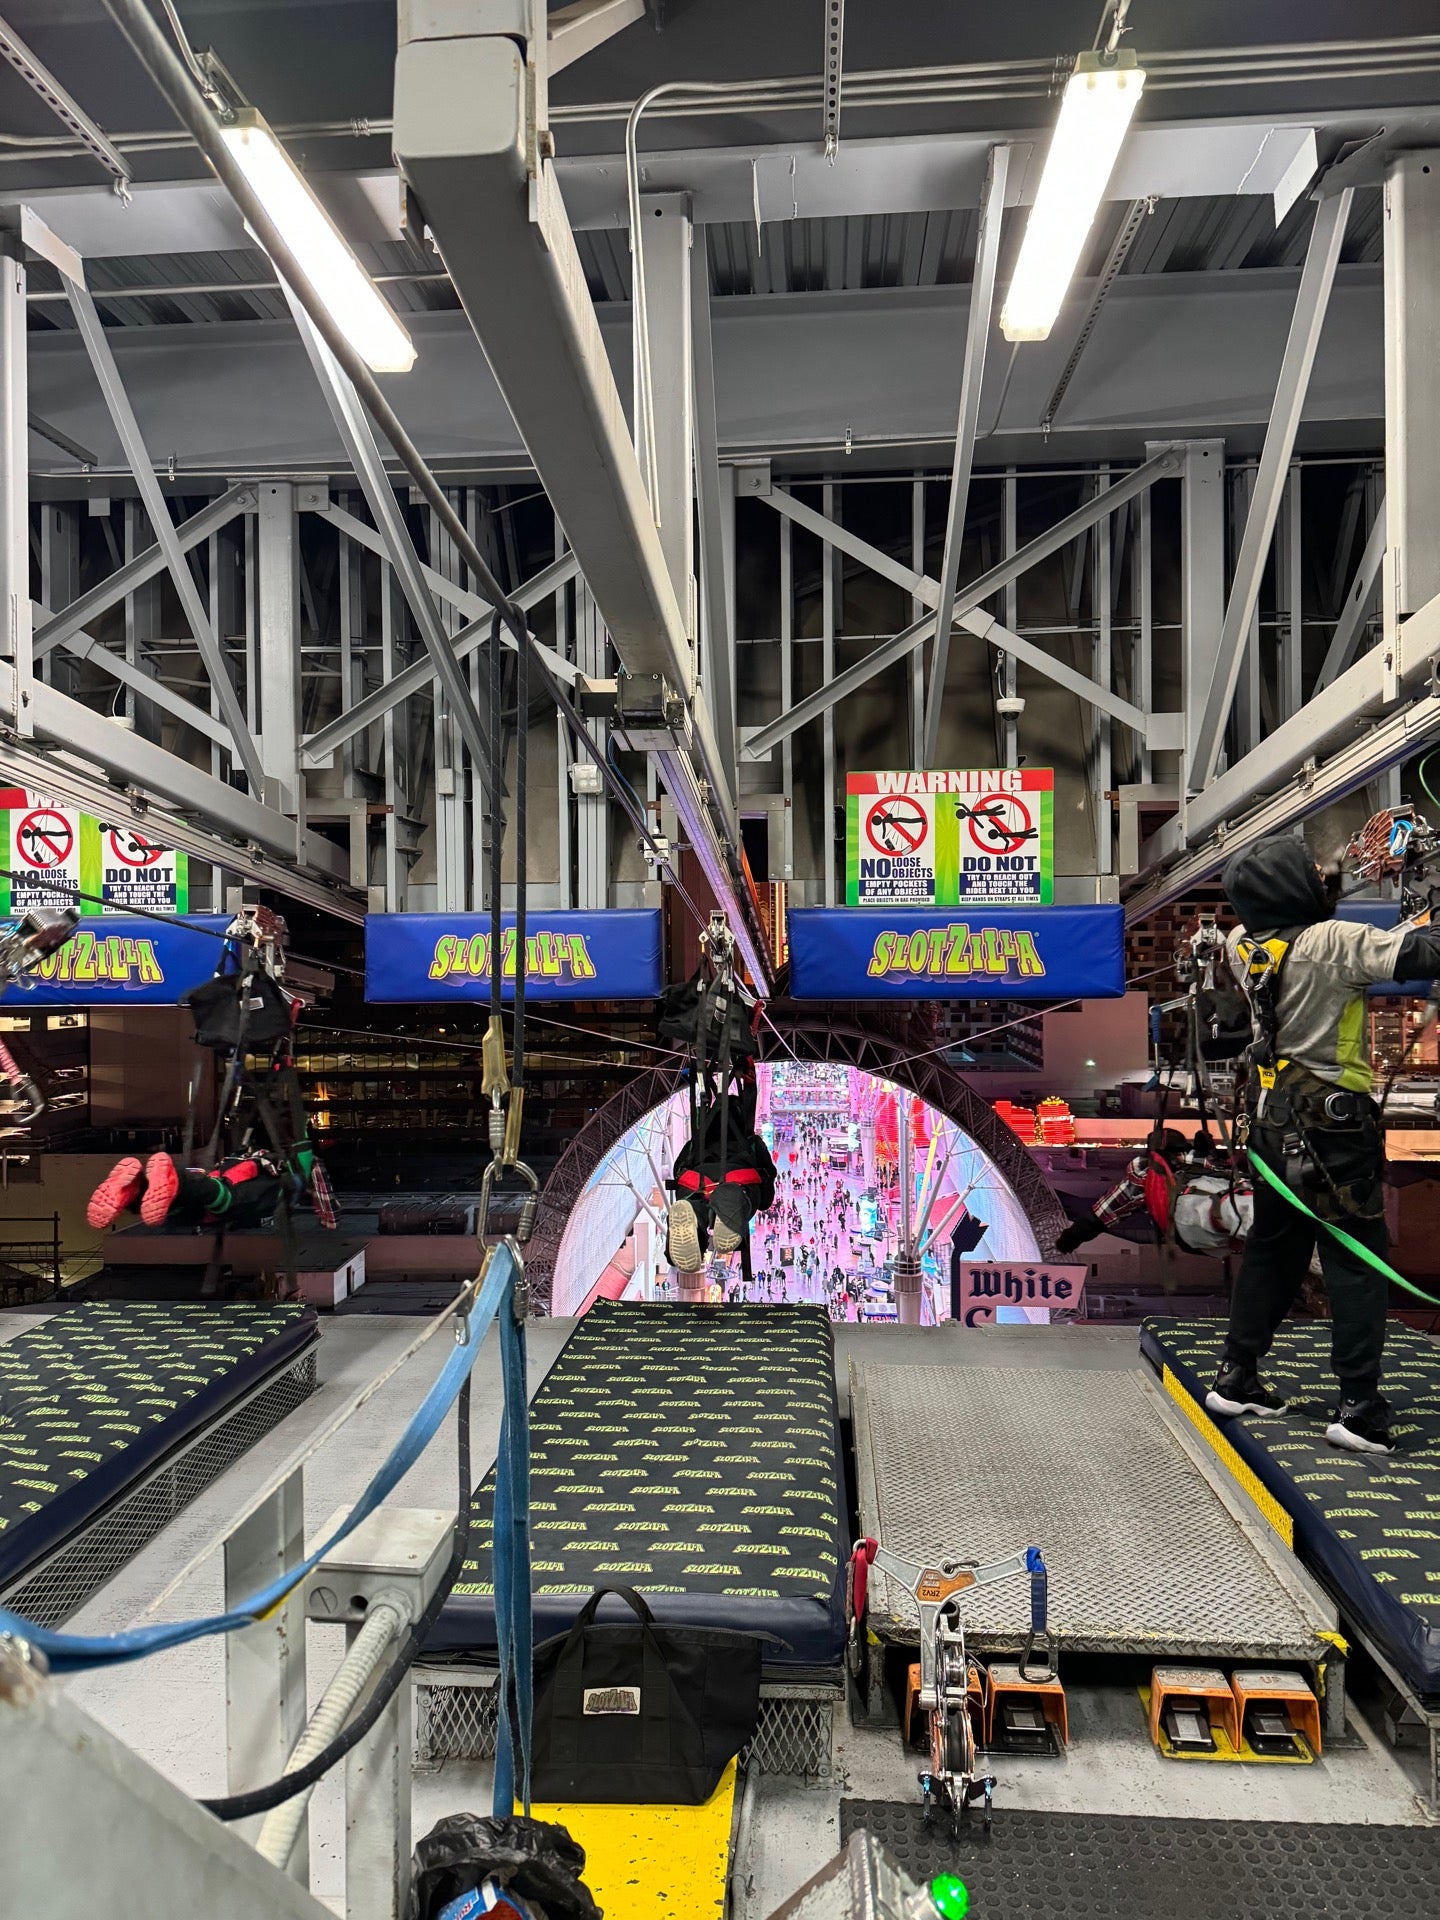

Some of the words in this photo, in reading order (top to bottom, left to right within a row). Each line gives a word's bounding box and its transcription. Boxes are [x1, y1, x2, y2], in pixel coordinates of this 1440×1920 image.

[875, 770, 1022, 793] WARNING
[861, 858, 891, 878] NO
[892, 857, 921, 867] LOOSE
[963, 856, 991, 871] DO
[996, 856, 1037, 871] NOT
[12, 870, 40, 889] NO
[41, 869, 67, 878] LOOSE
[106, 868, 131, 882] DO
[136, 868, 173, 882] NOT
[892, 868, 933, 878] OBJECTS
[865, 880, 891, 888] EMPTY
[893, 880, 928, 888] POCKETS
[16, 891, 40, 899] EMPTY
[865, 888, 875, 896] OF
[867, 923, 1046, 976] SLOTZILLA
[22, 932, 164, 984] OTZILLA
[969, 1268, 1073, 1304] White
[586, 1689, 637, 1711] SLOTZILLA
